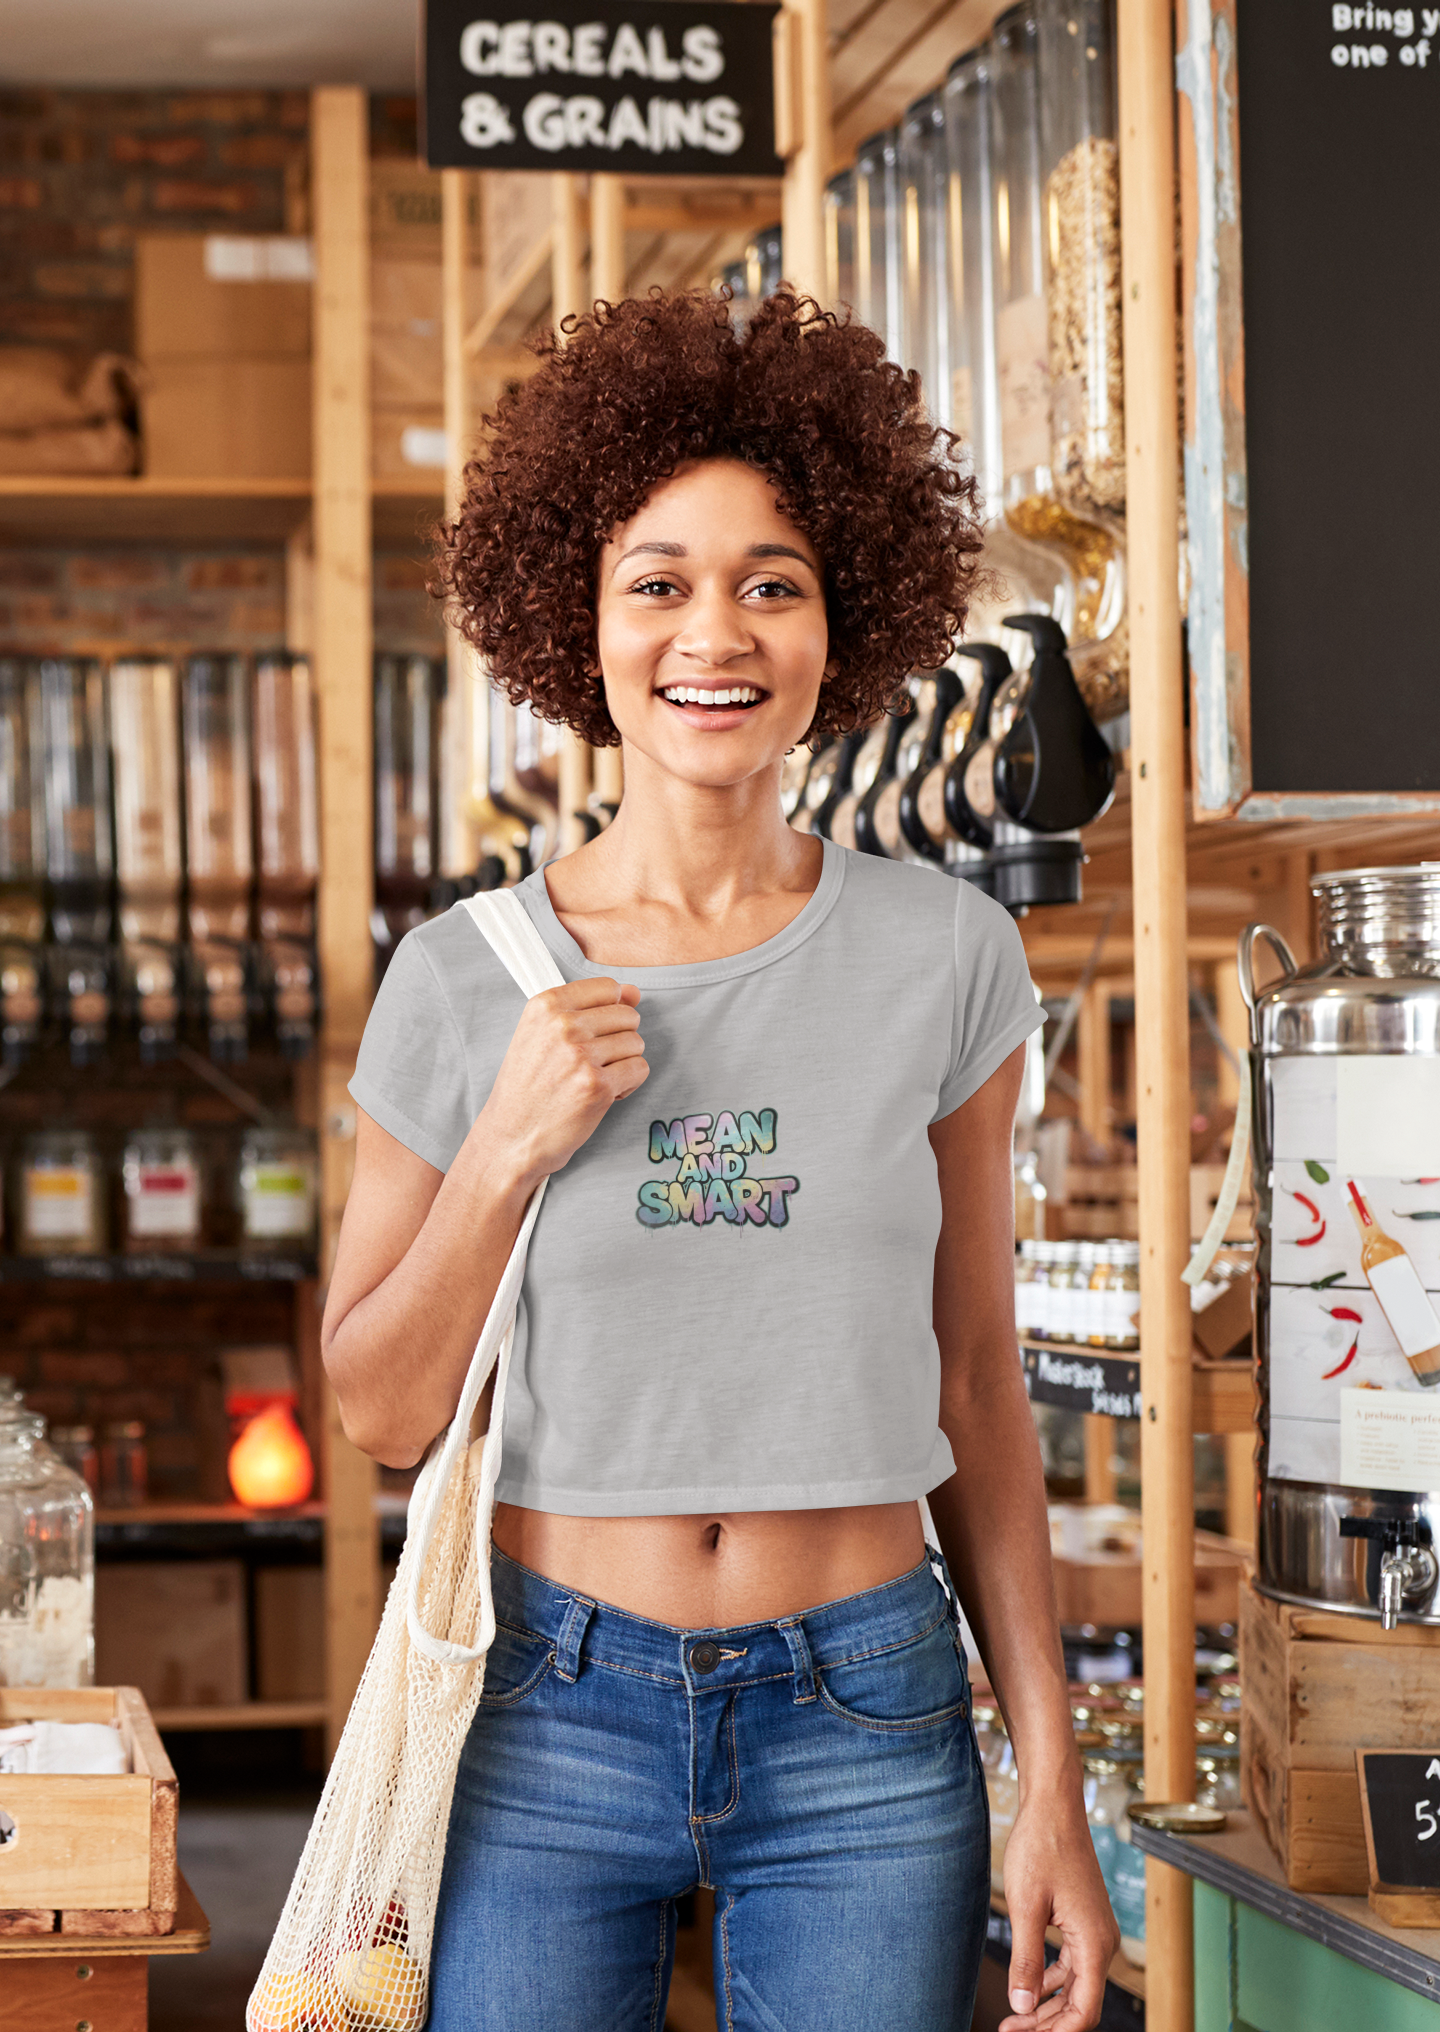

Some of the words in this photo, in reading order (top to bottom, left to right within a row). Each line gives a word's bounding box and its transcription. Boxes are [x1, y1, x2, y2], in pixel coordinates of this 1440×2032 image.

[1332, 0, 1414, 38] Bring
[1421, 8, 1440, 37] y
[460, 20, 725, 83] CEREALS
[1331, 43, 1388, 68] one
[1399, 38, 1431, 68] of
[460, 92, 516, 149] &
[523, 92, 744, 154] GRAINS
[648, 1107, 778, 1164] MEAN
[676, 1152, 747, 1183] AND
[636, 1175, 800, 1229] SMART
[1364, 1410, 1407, 1423] prebiotic
